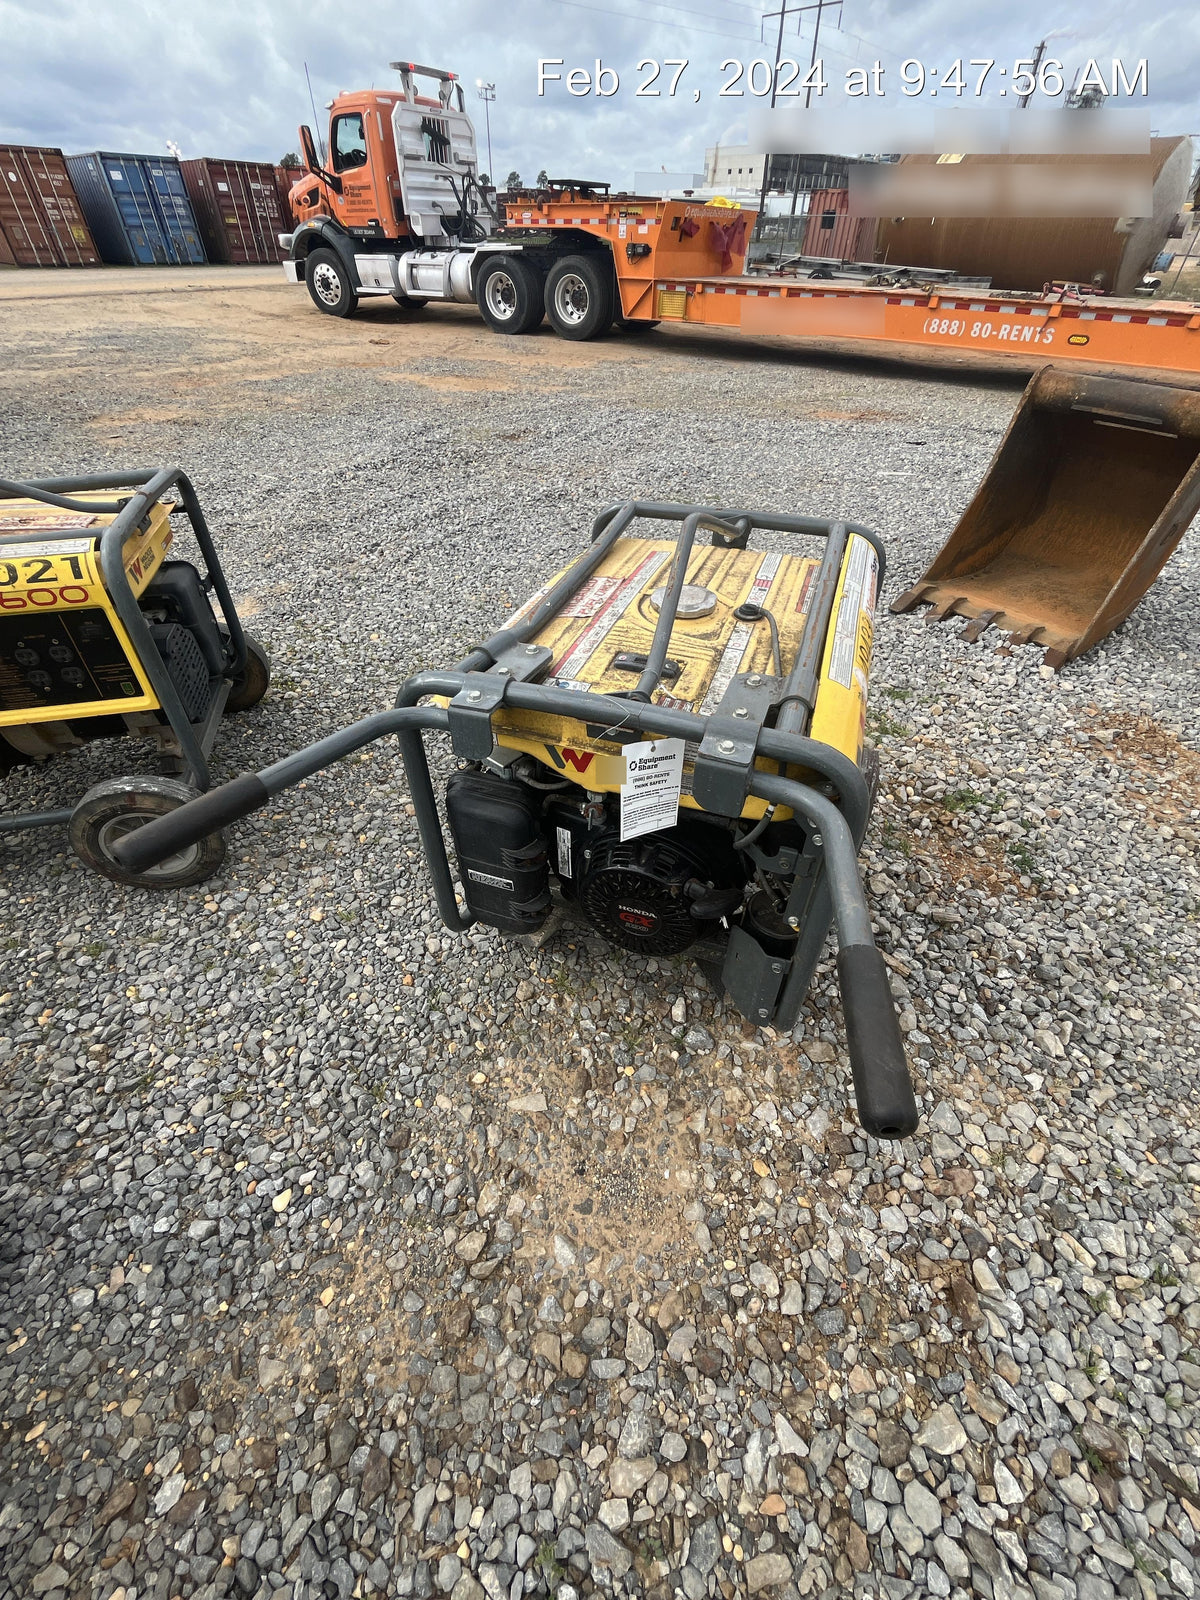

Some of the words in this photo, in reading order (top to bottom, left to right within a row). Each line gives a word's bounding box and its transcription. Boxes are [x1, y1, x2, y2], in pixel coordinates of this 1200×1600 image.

[923, 317, 966, 337] (888)
[970, 321, 1056, 345] 80-RENTS
[638, 754, 676, 764] Equipment
[638, 763, 659, 771] Share
[634, 782, 649, 790] THINK
[649, 778, 668, 787] SAFETY
[618, 904, 658, 919] HONDA
[619, 912, 655, 928] GX
